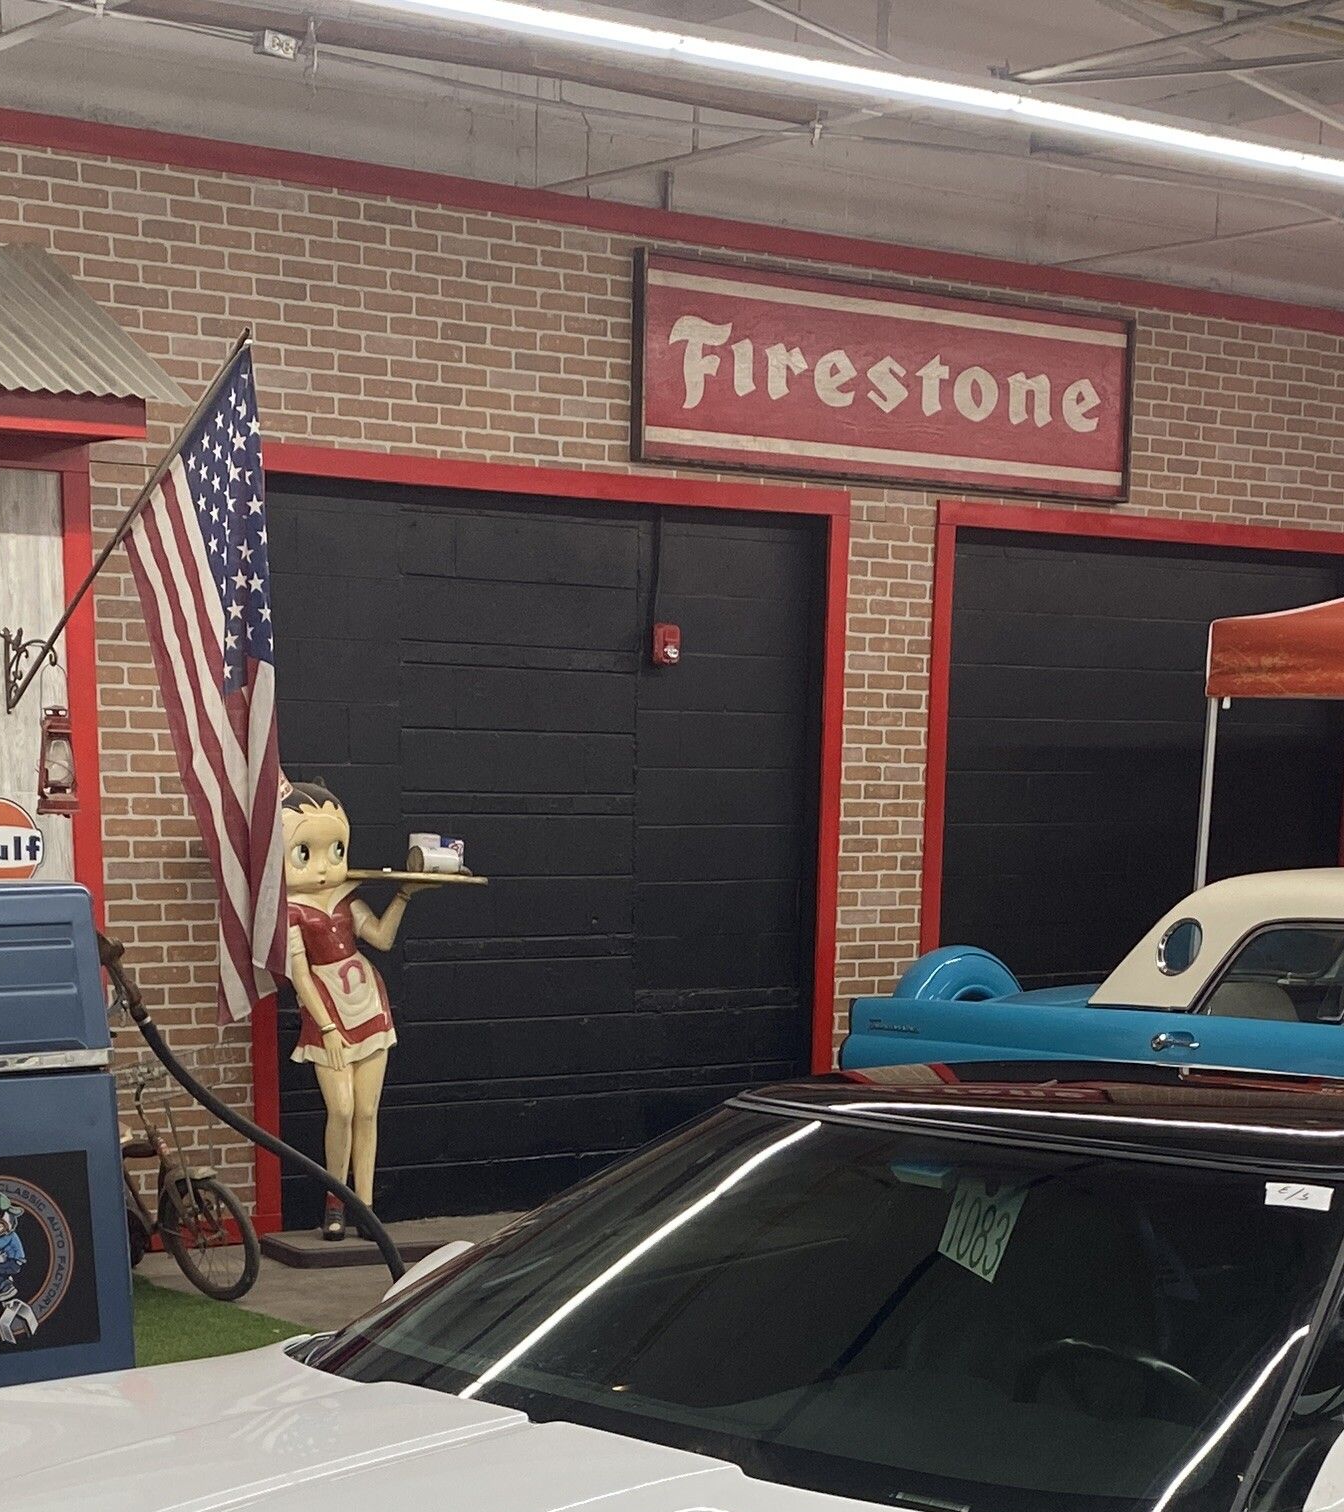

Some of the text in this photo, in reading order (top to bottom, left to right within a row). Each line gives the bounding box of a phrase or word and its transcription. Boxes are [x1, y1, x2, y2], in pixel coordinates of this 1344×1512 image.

[669, 315, 1102, 433] Firestone
[47, 1216, 66, 1250] AUTO
[945, 1190, 1011, 1276] 1083
[38, 1255, 66, 1312] FACTORY
